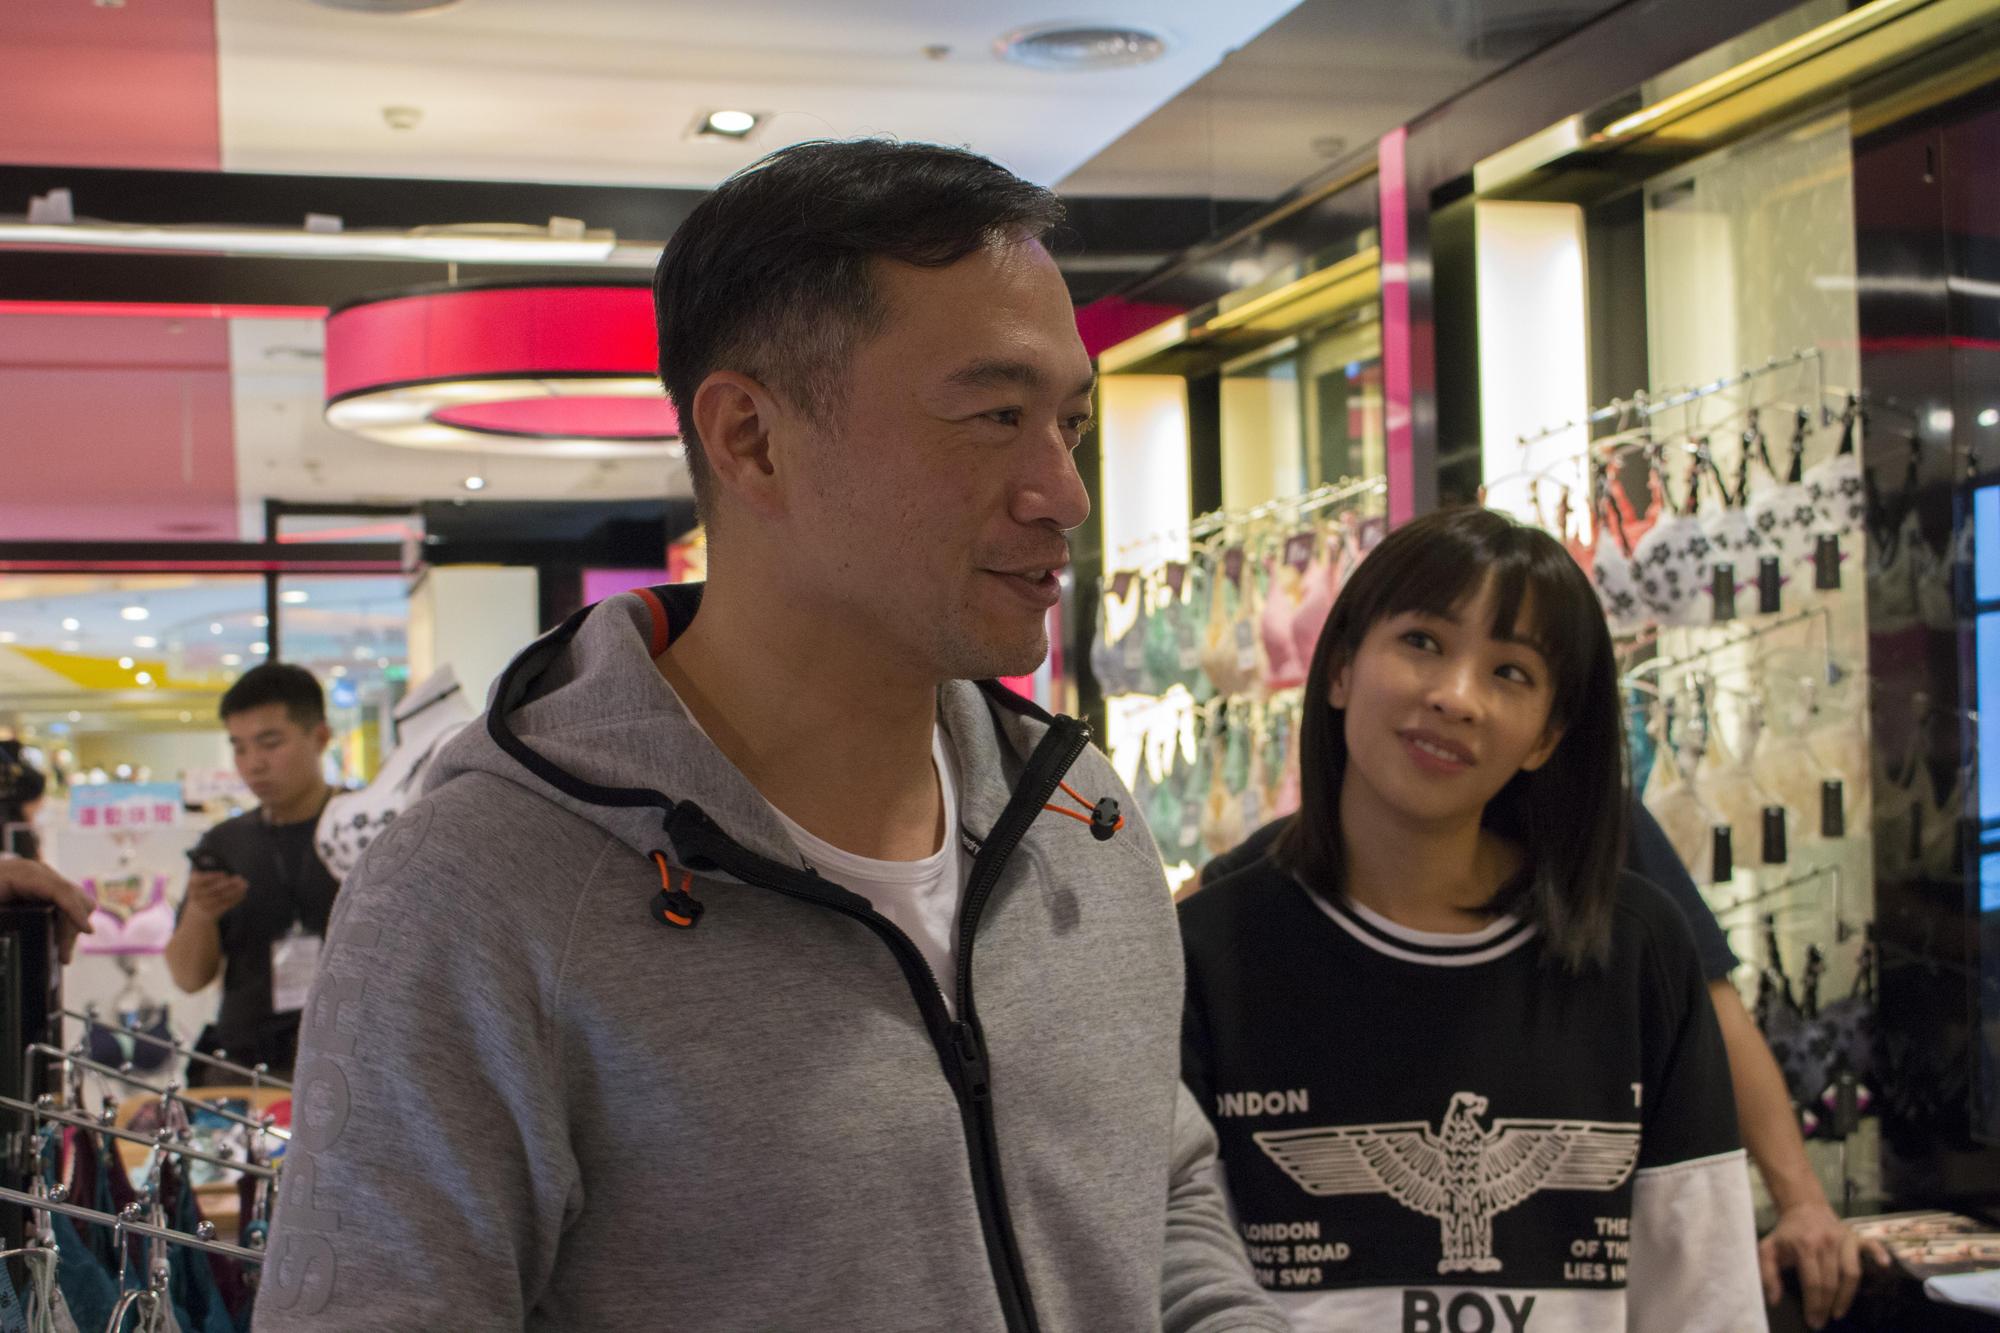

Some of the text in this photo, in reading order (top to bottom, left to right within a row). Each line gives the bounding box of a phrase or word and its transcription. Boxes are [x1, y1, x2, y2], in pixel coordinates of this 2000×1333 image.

[1217, 1088, 1309, 1117] NDON
[1295, 1242, 1350, 1262] ROAD
[1570, 1239, 1599, 1258] OF
[1279, 1267, 1322, 1286] SW3
[1564, 1262, 1607, 1281] LIES
[1402, 1290, 1536, 1333] BOY
